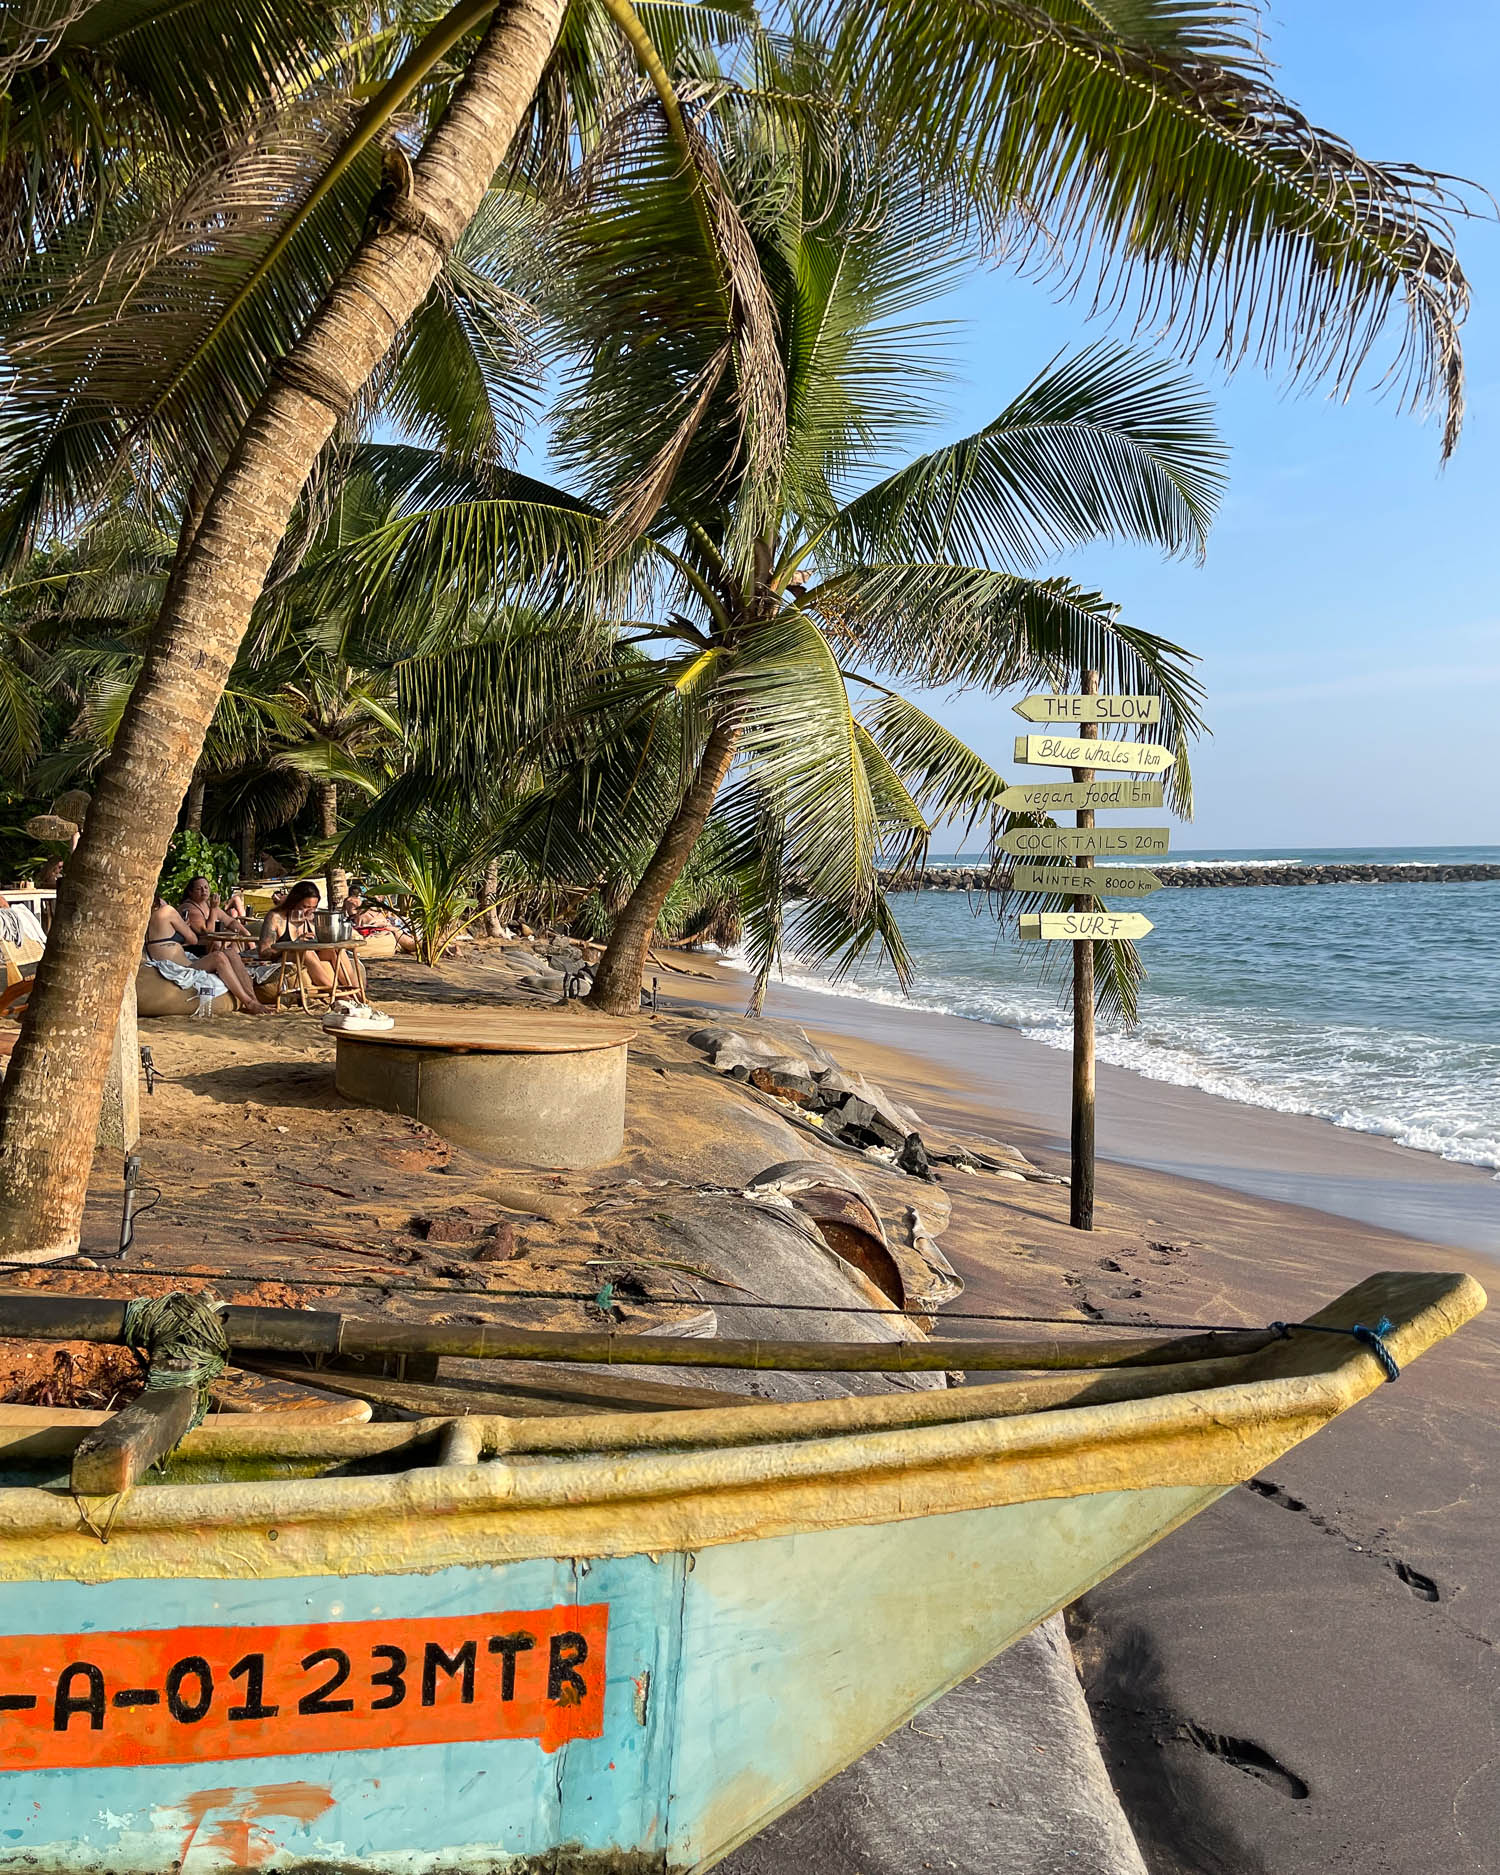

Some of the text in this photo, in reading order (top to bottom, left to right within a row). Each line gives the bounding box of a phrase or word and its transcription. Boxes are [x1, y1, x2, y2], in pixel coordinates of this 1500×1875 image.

[1044, 699, 1151, 718] THE SLOW
[1037, 740, 1080, 759] Blue
[1085, 745, 1129, 763] whales
[1024, 784, 1151, 810] vegan food 5m
[1016, 835, 1164, 849] COCKTAILS 20m
[1033, 871, 1096, 887] WINTER
[1064, 916, 1122, 935] SURF
